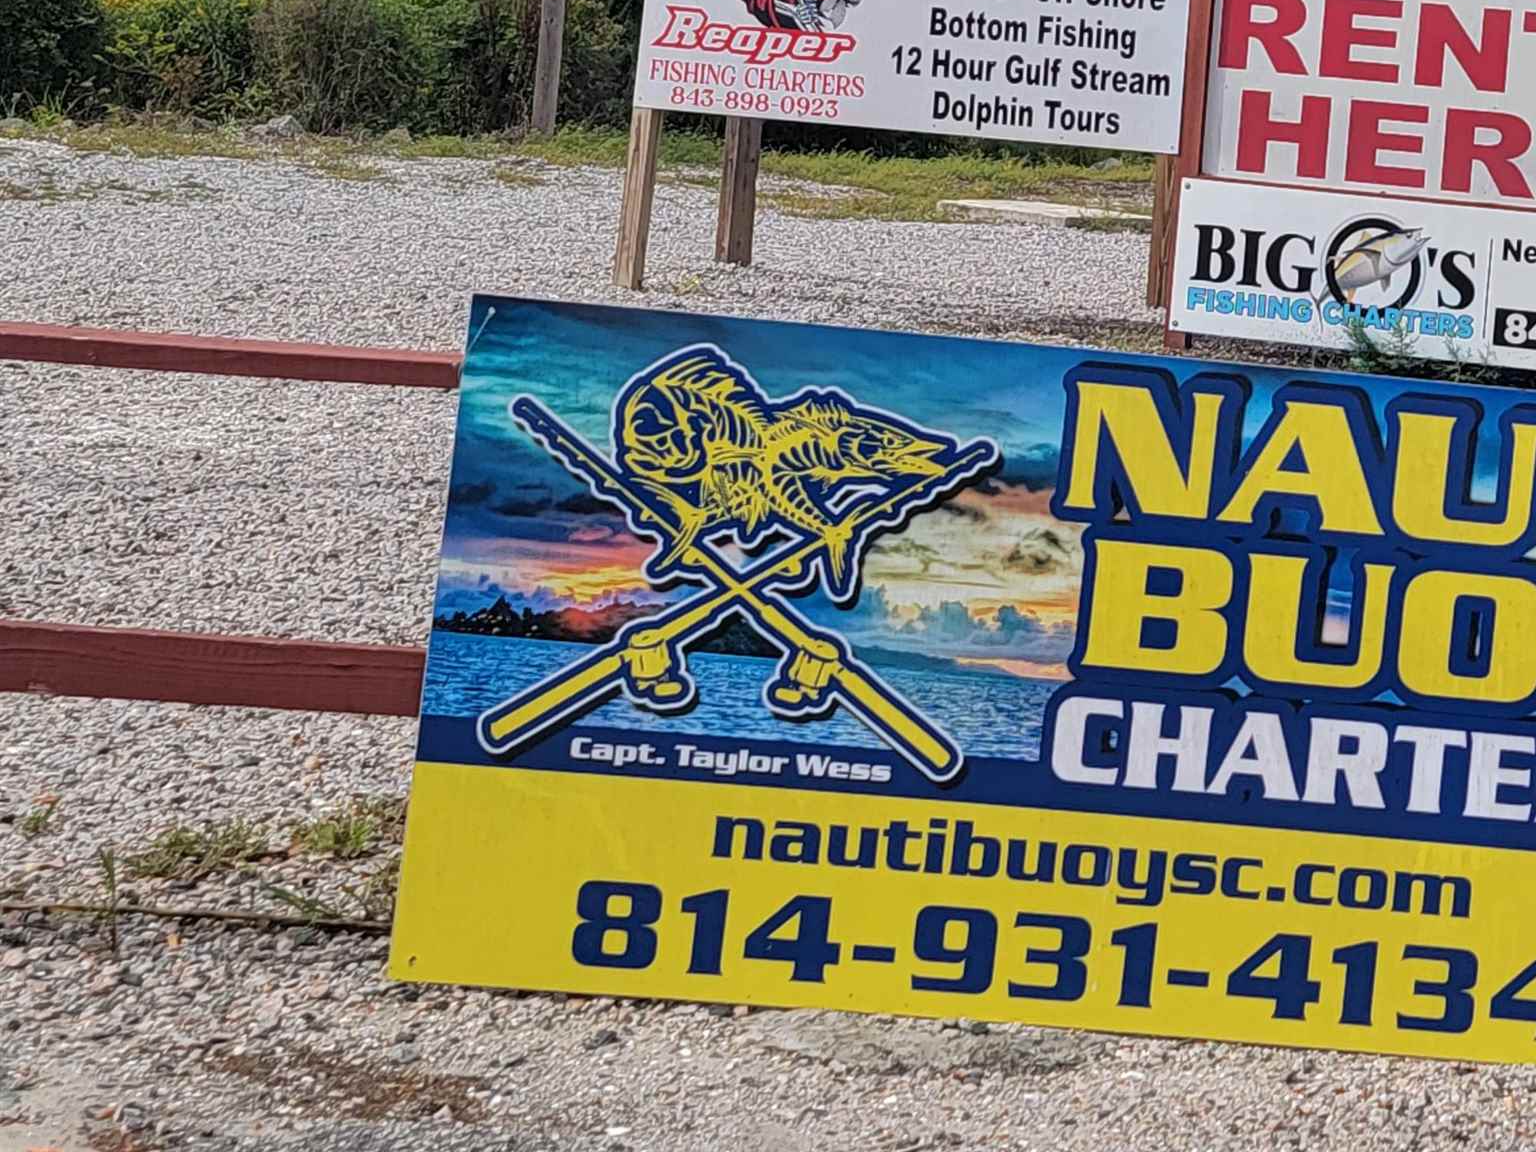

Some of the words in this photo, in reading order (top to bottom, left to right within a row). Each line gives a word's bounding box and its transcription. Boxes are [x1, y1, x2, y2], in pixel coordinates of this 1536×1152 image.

[650, 4, 856, 64] Reaper
[929, 8, 1028, 44] Bottom
[1037, 15, 1138, 59] Fishing
[649, 60, 736, 86] FISHING
[744, 65, 865, 97] CHARTERS
[891, 46, 921, 76] 12
[931, 49, 996, 82] Hour
[1005, 55, 1060, 88] Gulf
[1070, 59, 1170, 96] Stream
[670, 86, 839, 119] 843-898-0923
[931, 91, 1034, 131] Dolphin
[1045, 100, 1121, 135] Tours
[1190, 224, 1318, 293] BIG
[1186, 286, 1313, 321] FISHING
[1323, 301, 1474, 339] CHARTERS
[569, 735, 665, 769] Capt.
[674, 742, 788, 778] Taylor
[795, 749, 893, 783] Wess
[711, 808, 1475, 920] nautibuoysc.com
